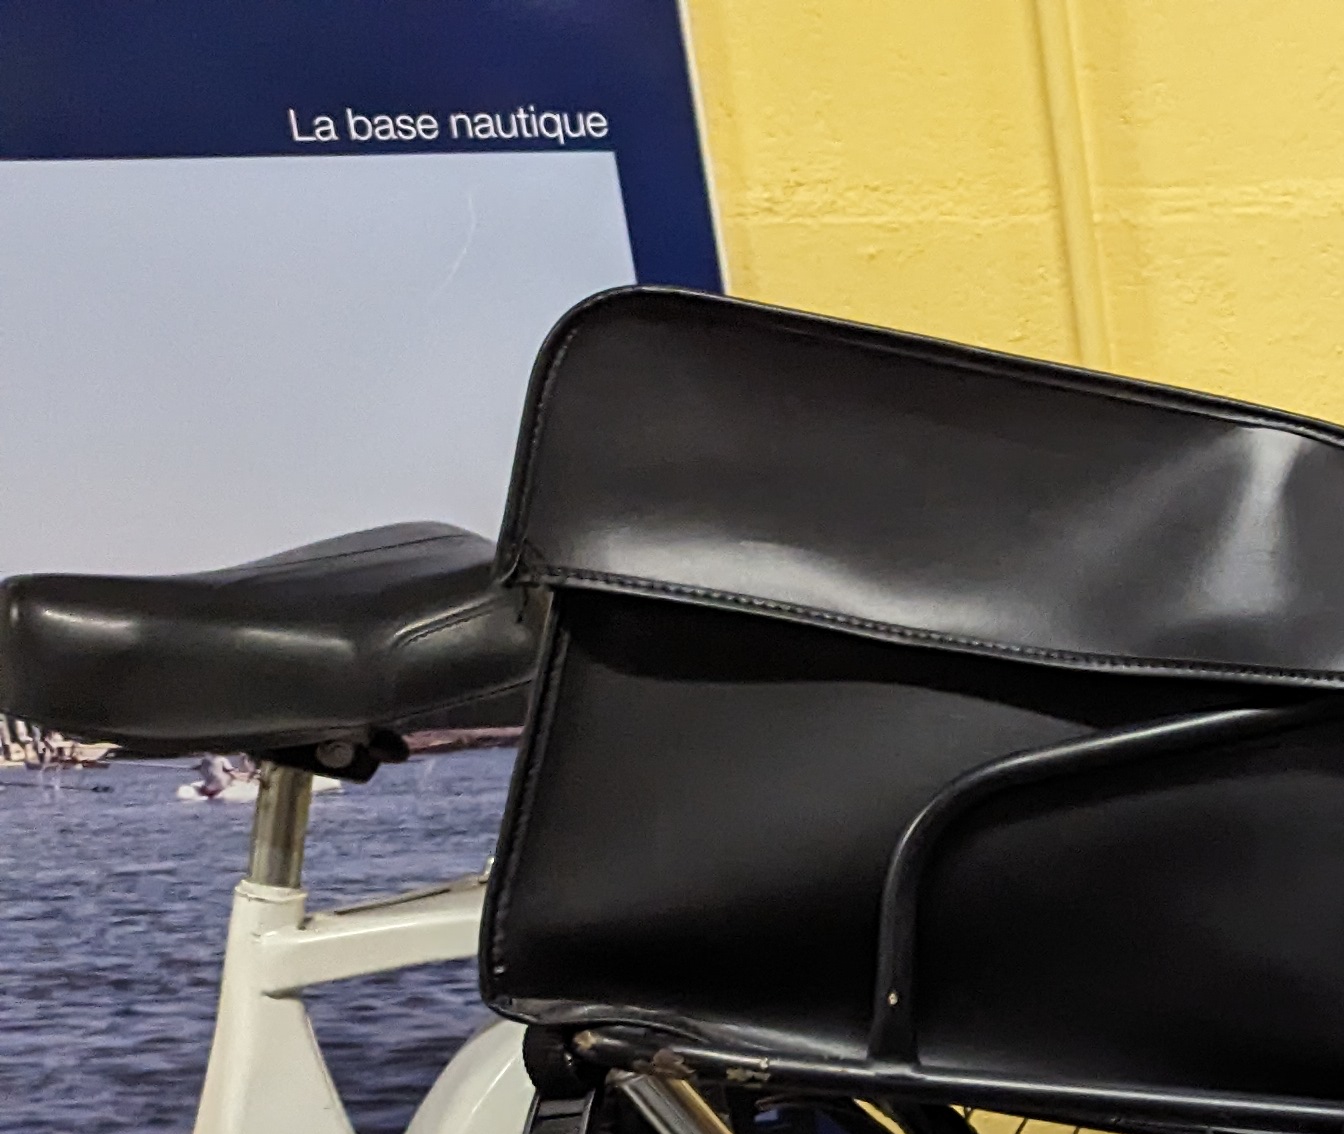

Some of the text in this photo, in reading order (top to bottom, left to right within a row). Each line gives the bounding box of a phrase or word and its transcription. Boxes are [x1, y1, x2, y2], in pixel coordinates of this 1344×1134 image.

[289, 105, 608, 145] La base nautique
